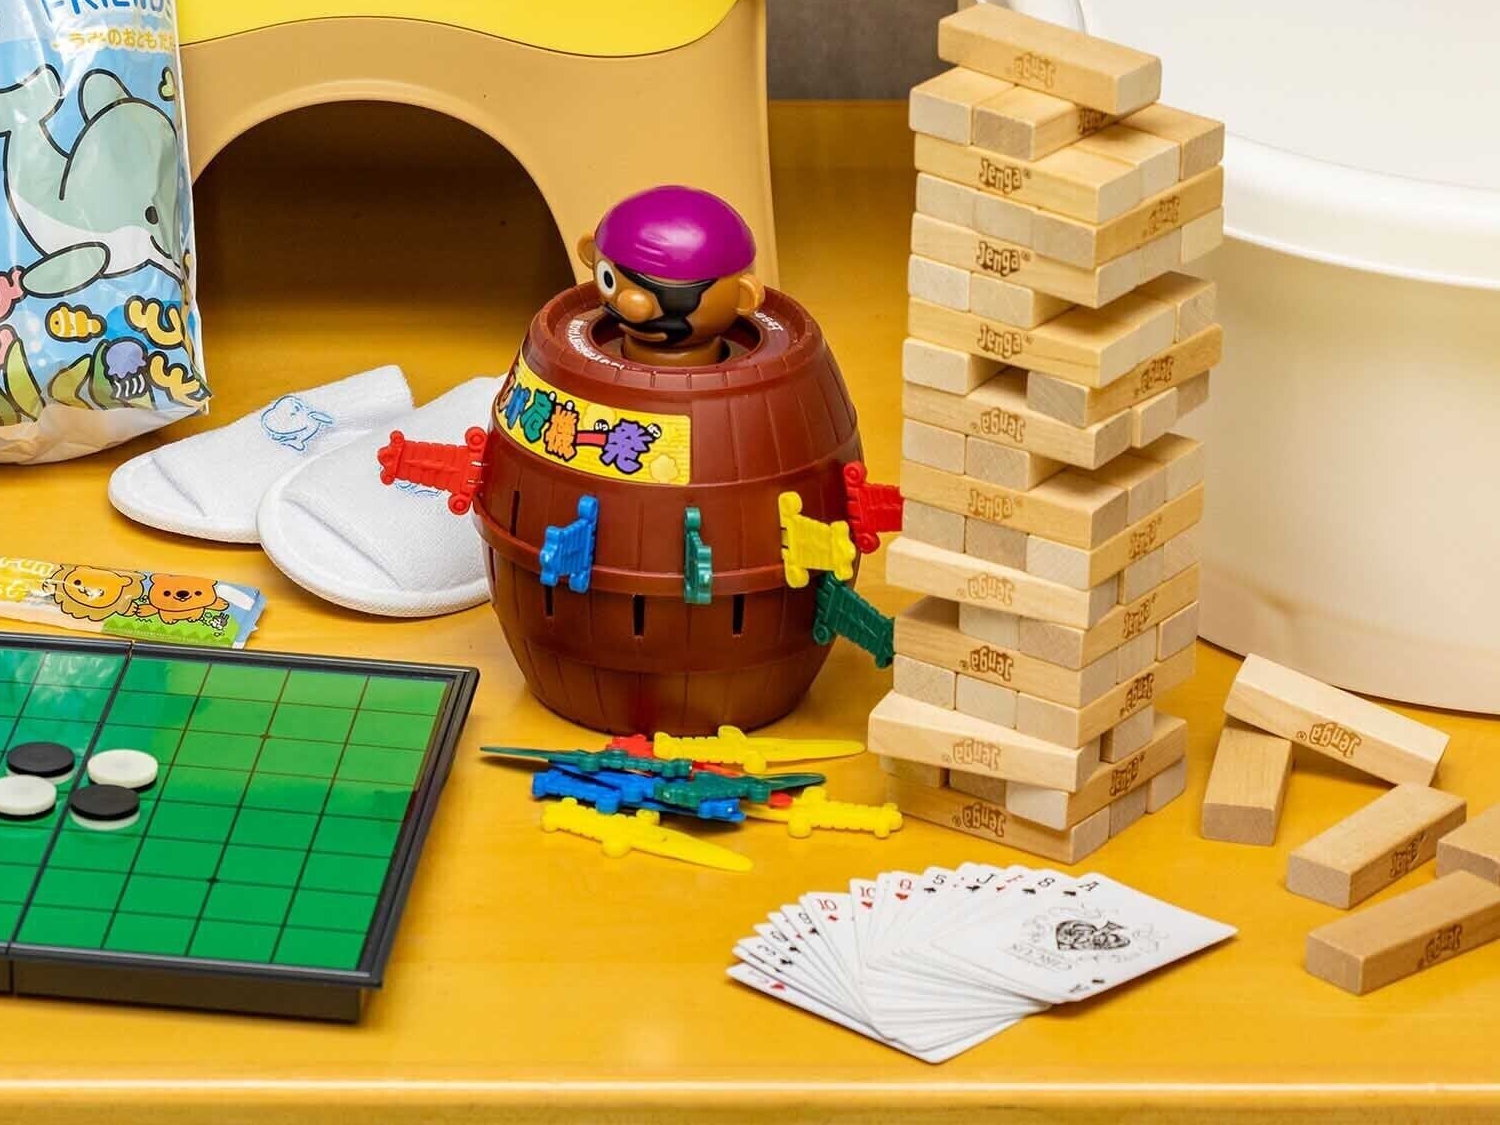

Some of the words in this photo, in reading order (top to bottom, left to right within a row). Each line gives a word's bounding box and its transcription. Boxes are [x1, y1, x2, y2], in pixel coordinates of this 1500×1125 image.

[979, 158, 1022, 195] Jenga
[976, 241, 1021, 276] Jenga
[977, 325, 1022, 358] Jenga
[980, 408, 1026, 442] Jenga
[968, 489, 1013, 521] Jenga
[967, 573, 1015, 606] Jenga
[970, 647, 1013, 682] Jenga
[953, 739, 1000, 771] Jenga
[1309, 722, 1362, 757] Jenga
[962, 803, 1006, 837] Jenga
[1078, 881, 1099, 892] A
[816, 898, 838, 912] 10
